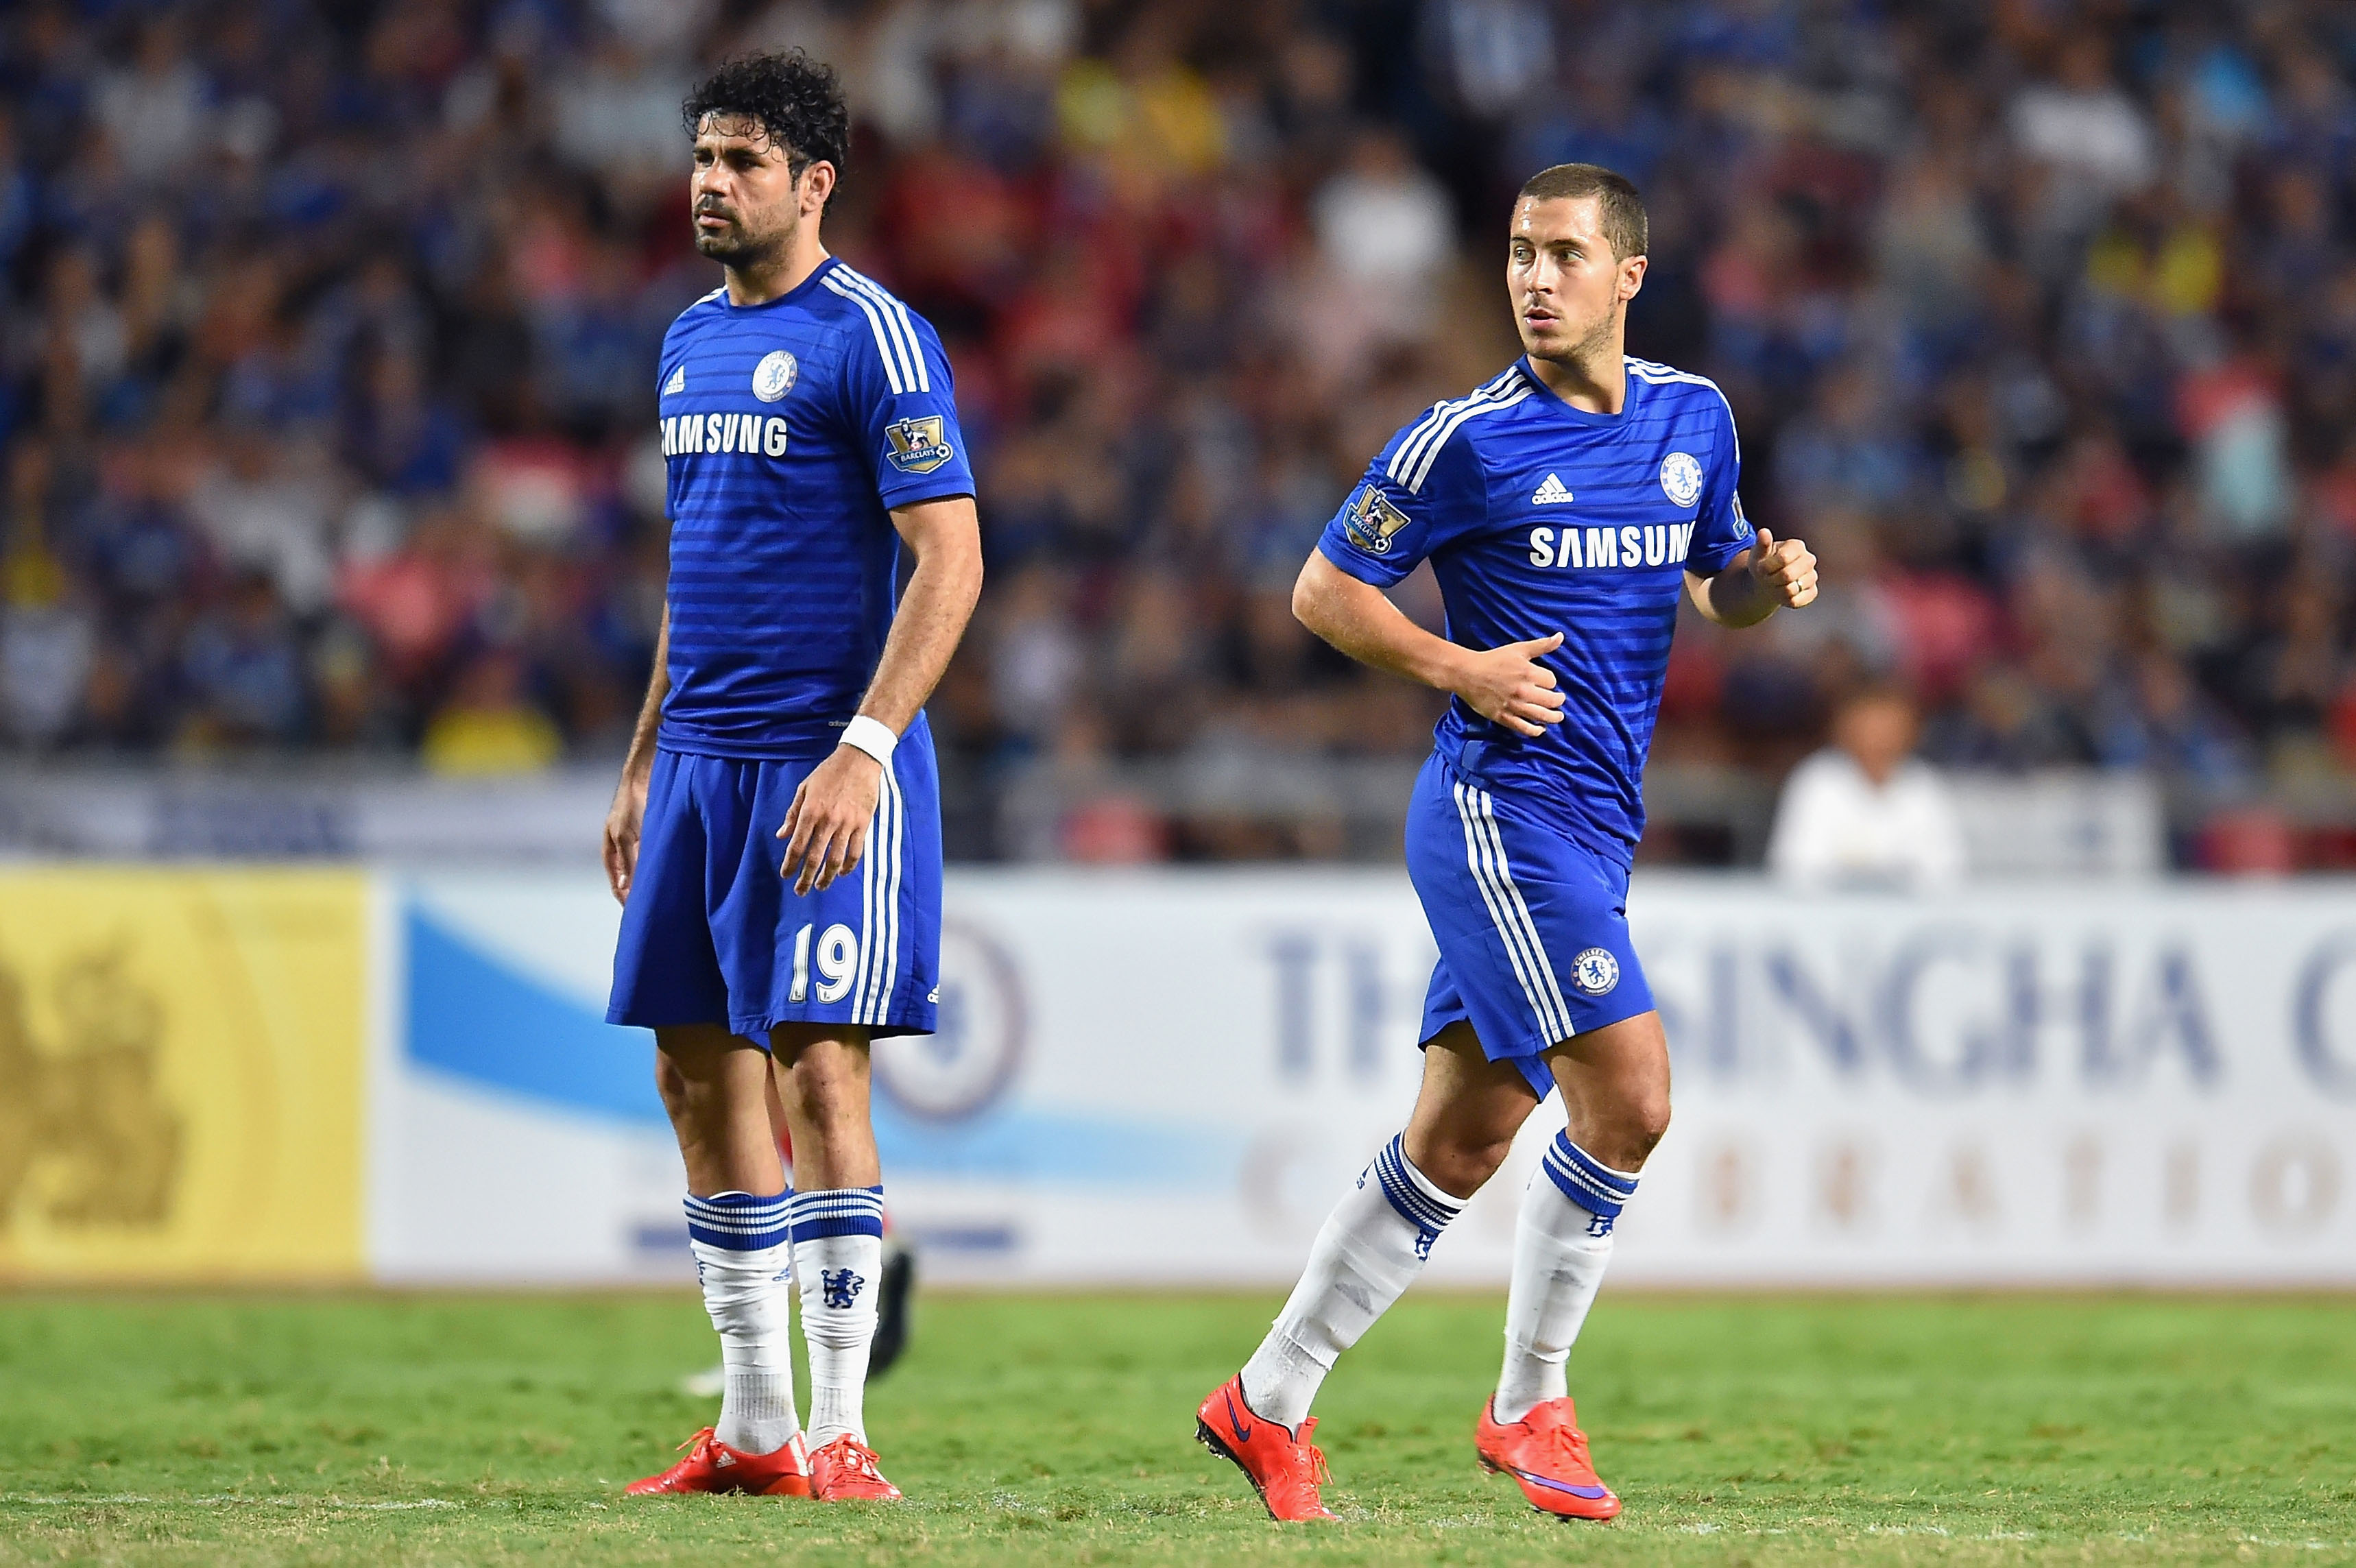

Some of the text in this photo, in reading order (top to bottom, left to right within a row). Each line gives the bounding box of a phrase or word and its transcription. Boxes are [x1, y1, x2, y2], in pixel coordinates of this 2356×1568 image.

[900, 449, 935, 462] BARCLAYS
[1531, 492, 1574, 505] adidas
[1350, 514, 1376, 540] BARCLAYS
[1530, 520, 1696, 568] SAMSUN
[789, 924, 858, 1004] 19
[1575, 950, 1604, 966] CHELSEA
